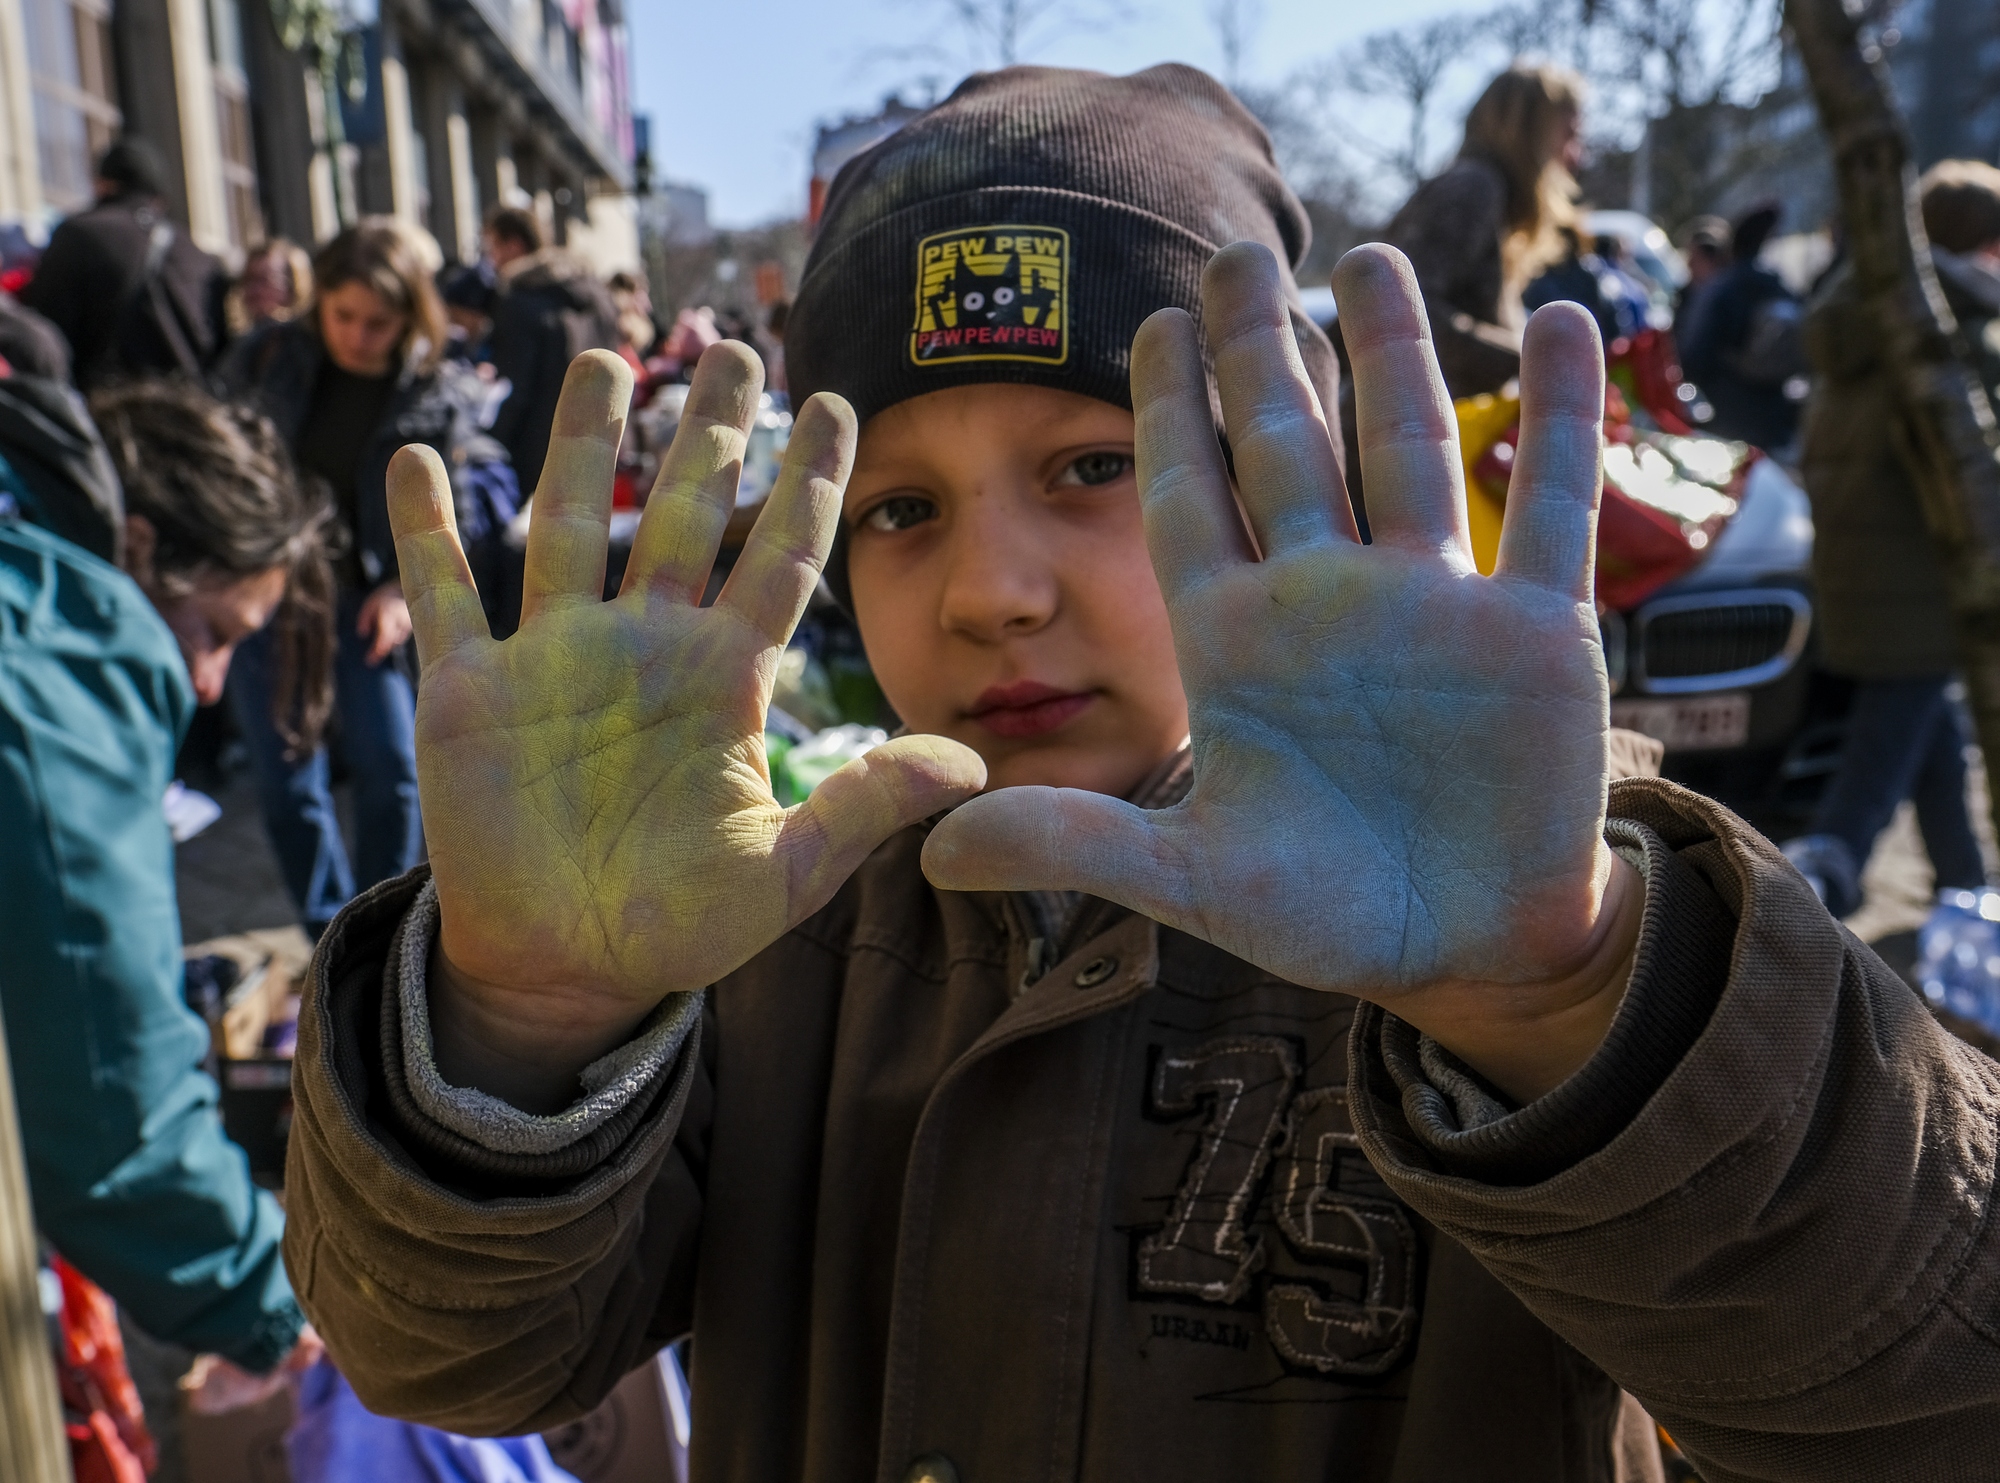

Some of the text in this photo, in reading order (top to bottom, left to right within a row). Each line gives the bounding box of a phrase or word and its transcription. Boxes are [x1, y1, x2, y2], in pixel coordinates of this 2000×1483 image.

[925, 236, 1061, 264] PEW PEW
[917, 328, 962, 349] PEW
[1013, 328, 1059, 347] PEW
[1128, 1036, 1417, 1374] 75
[1151, 1313, 1250, 1351] URBAN
